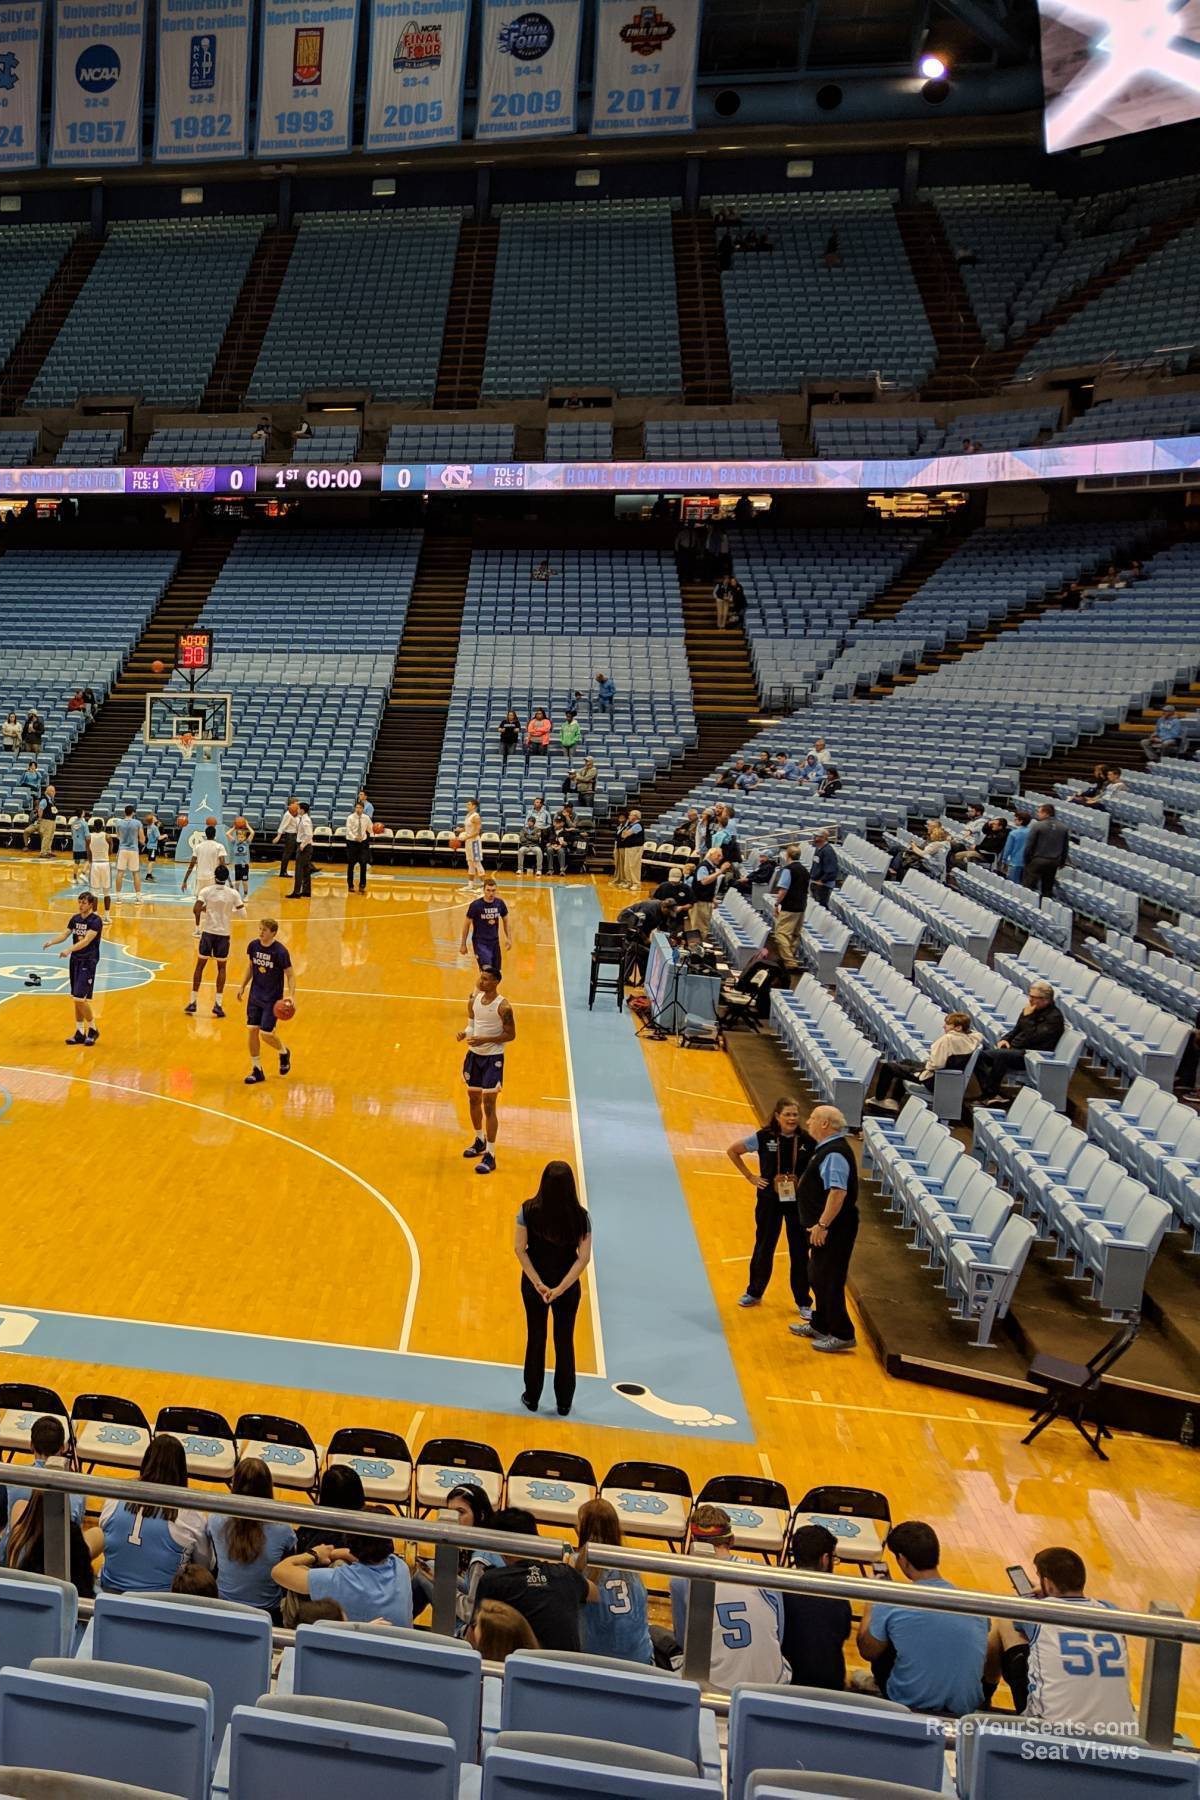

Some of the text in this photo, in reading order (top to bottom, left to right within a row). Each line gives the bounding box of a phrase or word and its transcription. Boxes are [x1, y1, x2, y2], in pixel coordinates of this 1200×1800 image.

[24, 8, 36, 21] of
[63, 1, 138, 19] University of
[267, 7, 354, 26] North Carolina
[377, 0, 465, 17] North Carolina
[59, 22, 141, 40] North Carolina
[162, 14, 246, 32] North Carolina
[404, 33, 440, 46] FINAL
[510, 32, 548, 48] FOUR
[79, 66, 120, 82] NCAA
[490, 90, 562, 117] 2009
[607, 86, 681, 114] 2017
[274, 109, 335, 135] 1993
[383, 100, 443, 129] 2005
[65, 120, 127, 145] 1957
[170, 113, 232, 140] 1982
[21, 473, 63, 488] SMITH
[68, 473, 117, 488] CENTER
[132, 471, 159, 481] TOL: 4
[230, 470, 244, 490] 0
[305, 469, 363, 489] 60:00
[397, 469, 412, 489] 0
[494, 467, 524, 477] TOL: 4
[567, 467, 815, 484] HOME OF CAROLINA BASKETBALL
[132, 480, 159, 490] FLS: 0
[494, 477, 524, 487] FLS: 0
[184, 647, 205, 664] 30
[526, 1574, 548, 1584] 2018
[605, 1579, 632, 1616] 3
[716, 1602, 752, 1649] 5
[1059, 1632, 1126, 1677] 52
